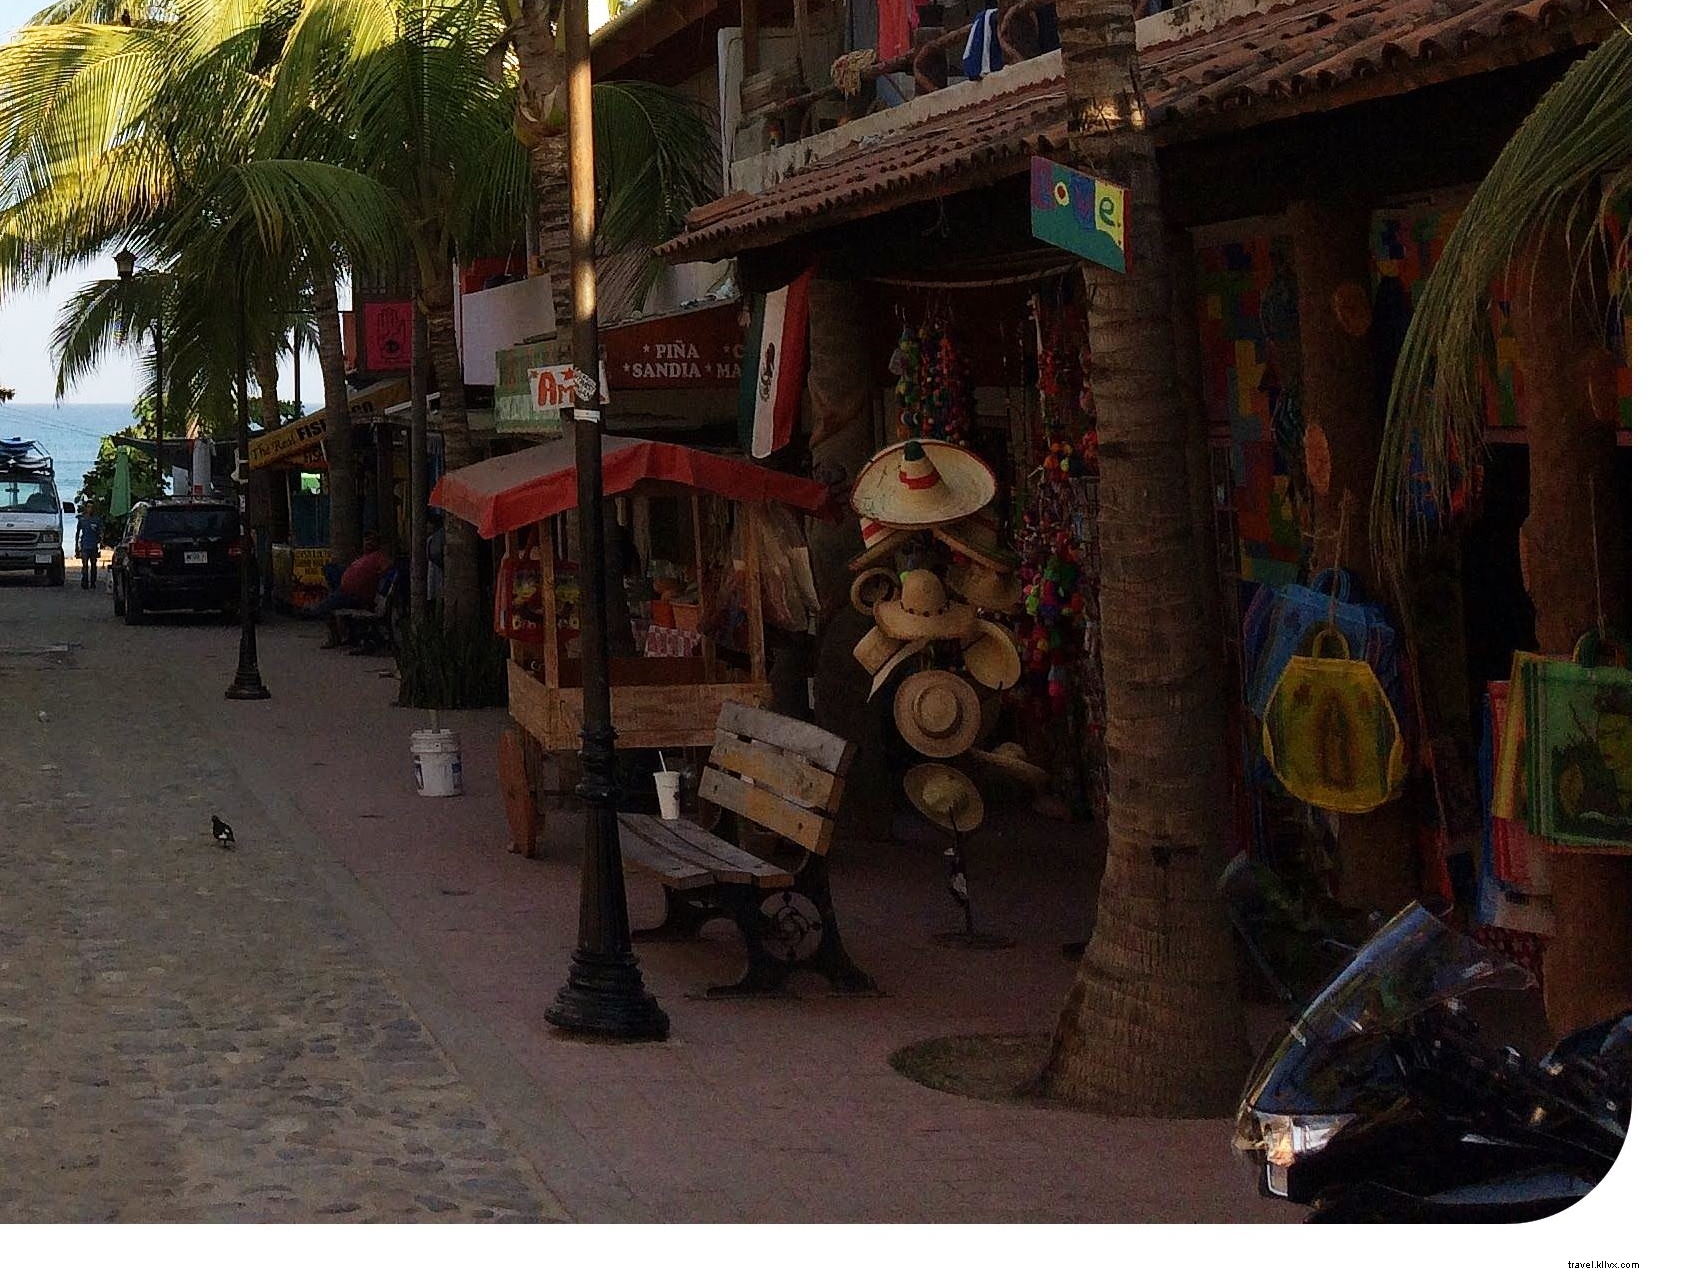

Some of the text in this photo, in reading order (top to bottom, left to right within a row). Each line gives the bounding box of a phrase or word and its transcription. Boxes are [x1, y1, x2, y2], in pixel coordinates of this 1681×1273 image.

[655, 339, 701, 359] PIÑA
[631, 362, 741, 378] SANDIA MA
